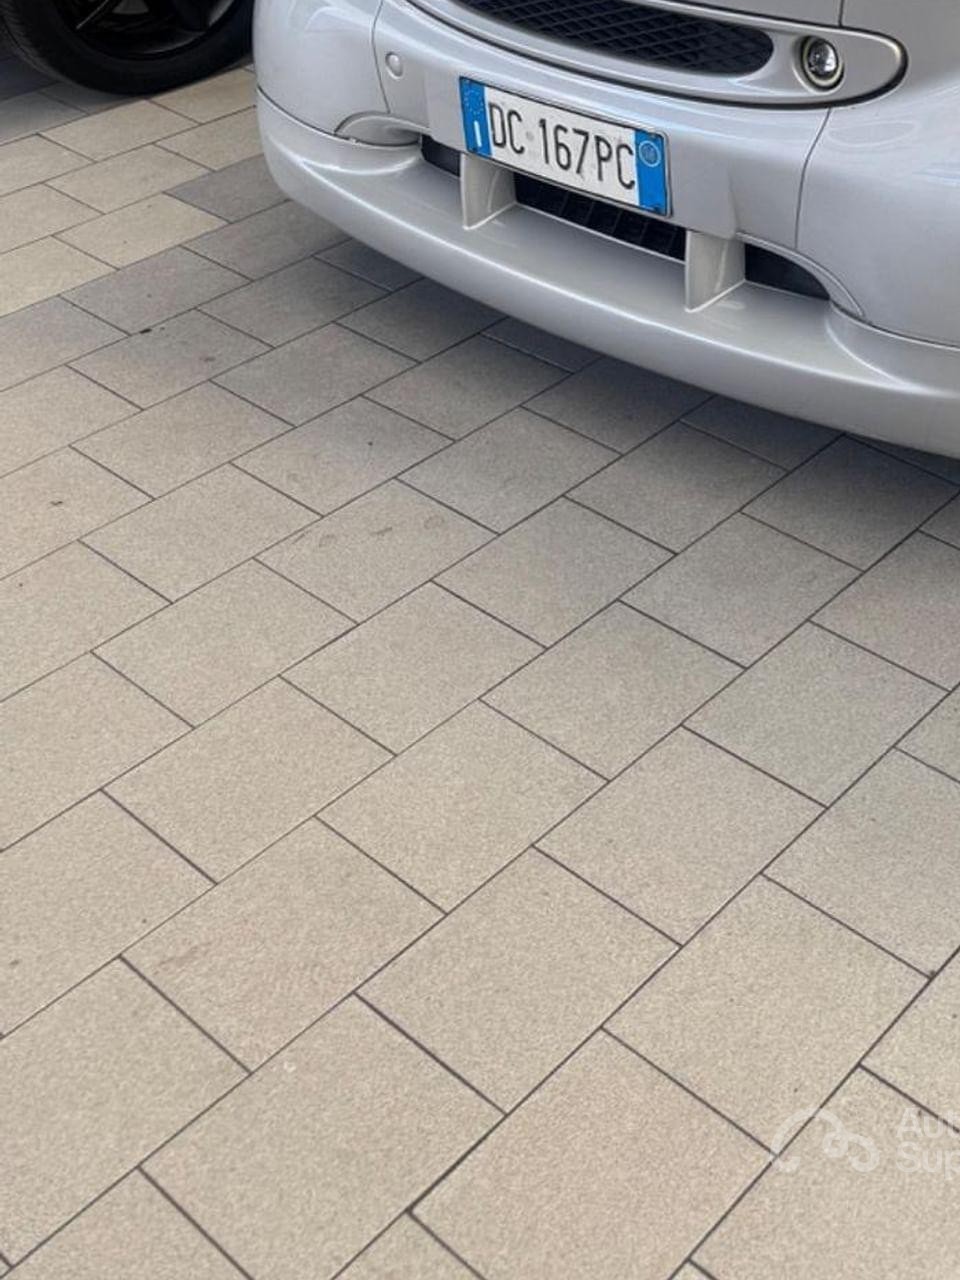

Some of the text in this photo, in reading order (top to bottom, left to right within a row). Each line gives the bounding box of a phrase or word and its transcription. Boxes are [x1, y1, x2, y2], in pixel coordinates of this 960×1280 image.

[474, 121, 482, 148] I
[489, 102, 635, 191] DC 167PC
